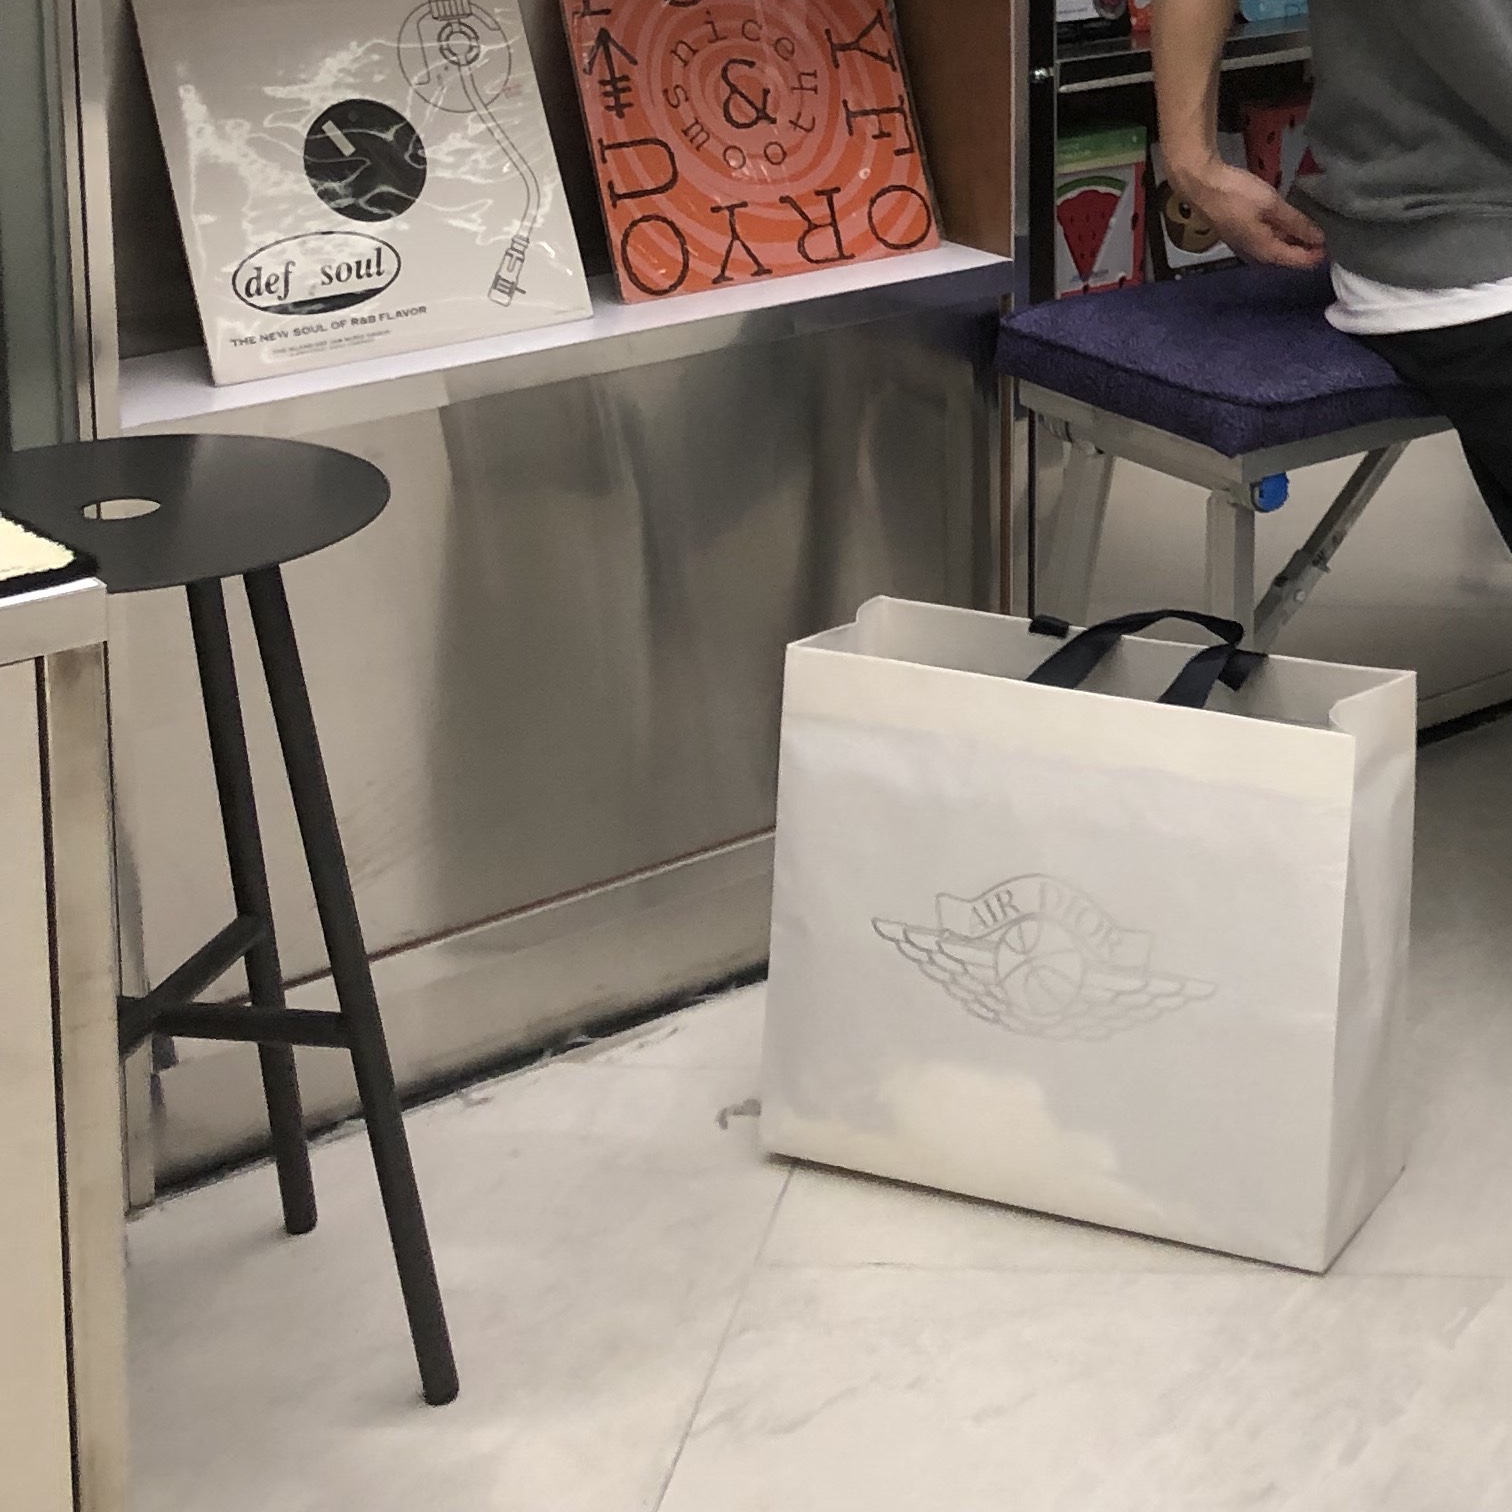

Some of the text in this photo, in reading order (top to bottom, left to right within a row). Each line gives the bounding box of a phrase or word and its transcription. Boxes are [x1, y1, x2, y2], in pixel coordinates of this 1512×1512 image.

[719, 58, 777, 130] &
[244, 246, 386, 301] def soul
[230, 305, 427, 348] THE NEW SOUL OF R&B FLAVOR
[969, 889, 1022, 929] AIR
